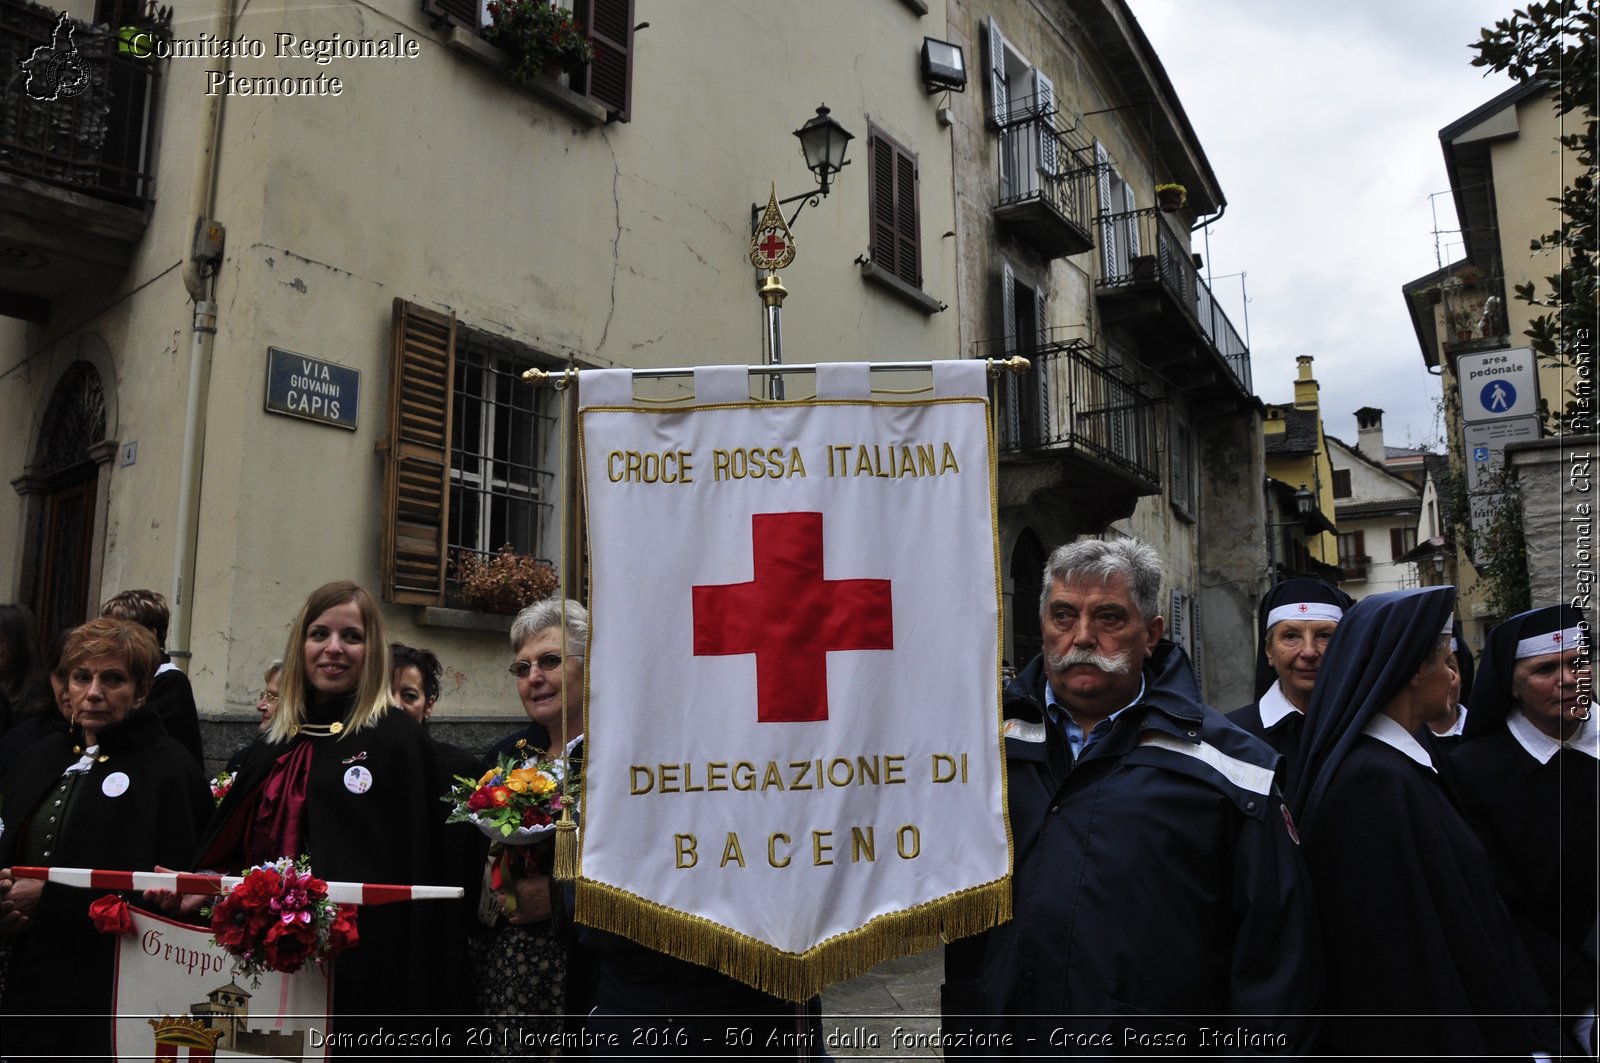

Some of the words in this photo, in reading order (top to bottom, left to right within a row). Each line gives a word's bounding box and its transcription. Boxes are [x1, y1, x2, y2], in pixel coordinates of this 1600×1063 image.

[302, 360, 330, 380] VIA
[1469, 364, 1523, 380] pedonale
[1482, 356, 1508, 366] area
[290, 374, 340, 398] GIOVANNI
[287, 390, 340, 419] CAPIS
[607, 449, 693, 484] CROCE
[713, 447, 807, 482] ROSSA
[826, 442, 960, 479] ITALIANA
[630, 754, 907, 796] DELEGAZIONE
[932, 752, 969, 785] DI
[674, 823, 921, 869] BACENO
[142, 929, 224, 977] Gruppo
